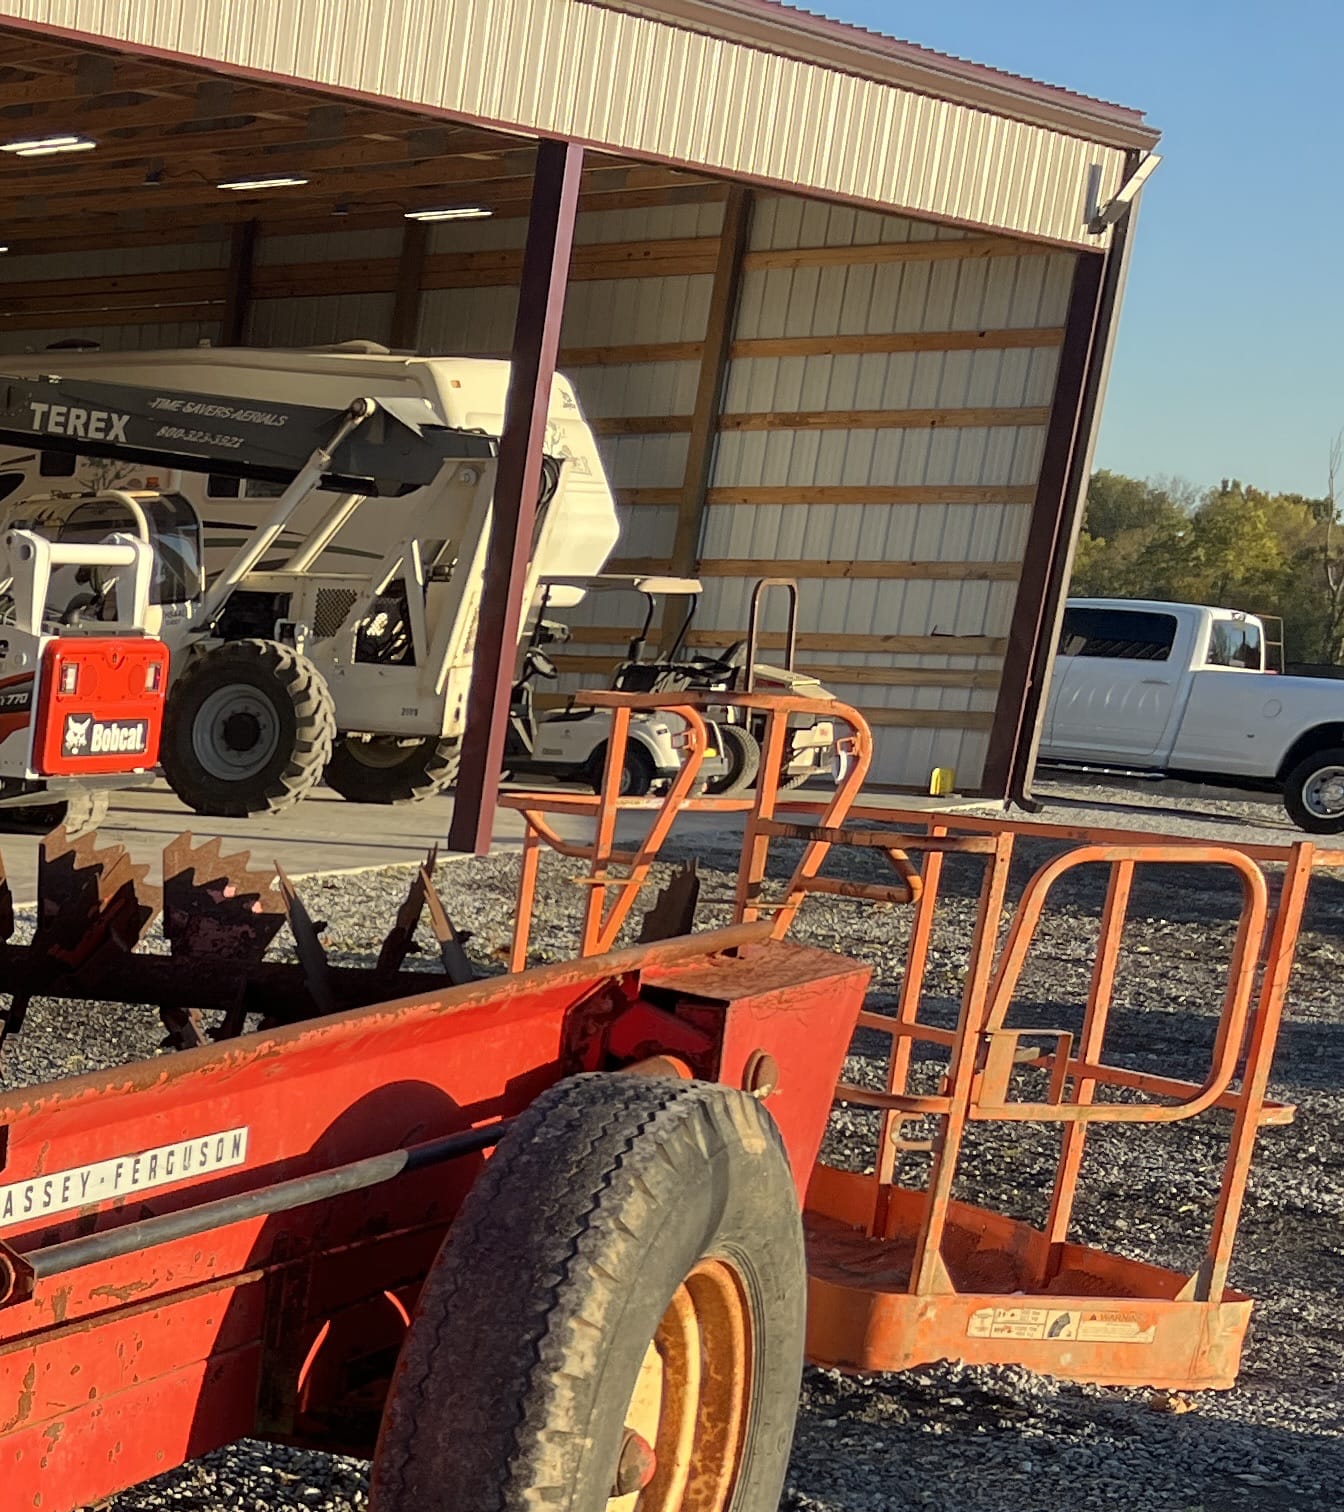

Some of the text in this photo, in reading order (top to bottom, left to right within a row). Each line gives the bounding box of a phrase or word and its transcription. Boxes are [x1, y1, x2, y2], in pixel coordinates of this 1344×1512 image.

[30, 402, 131, 442] TEREX
[149, 397, 288, 427] TIME SAVERS AERIALS
[90, 723, 145, 752] Bobcat
